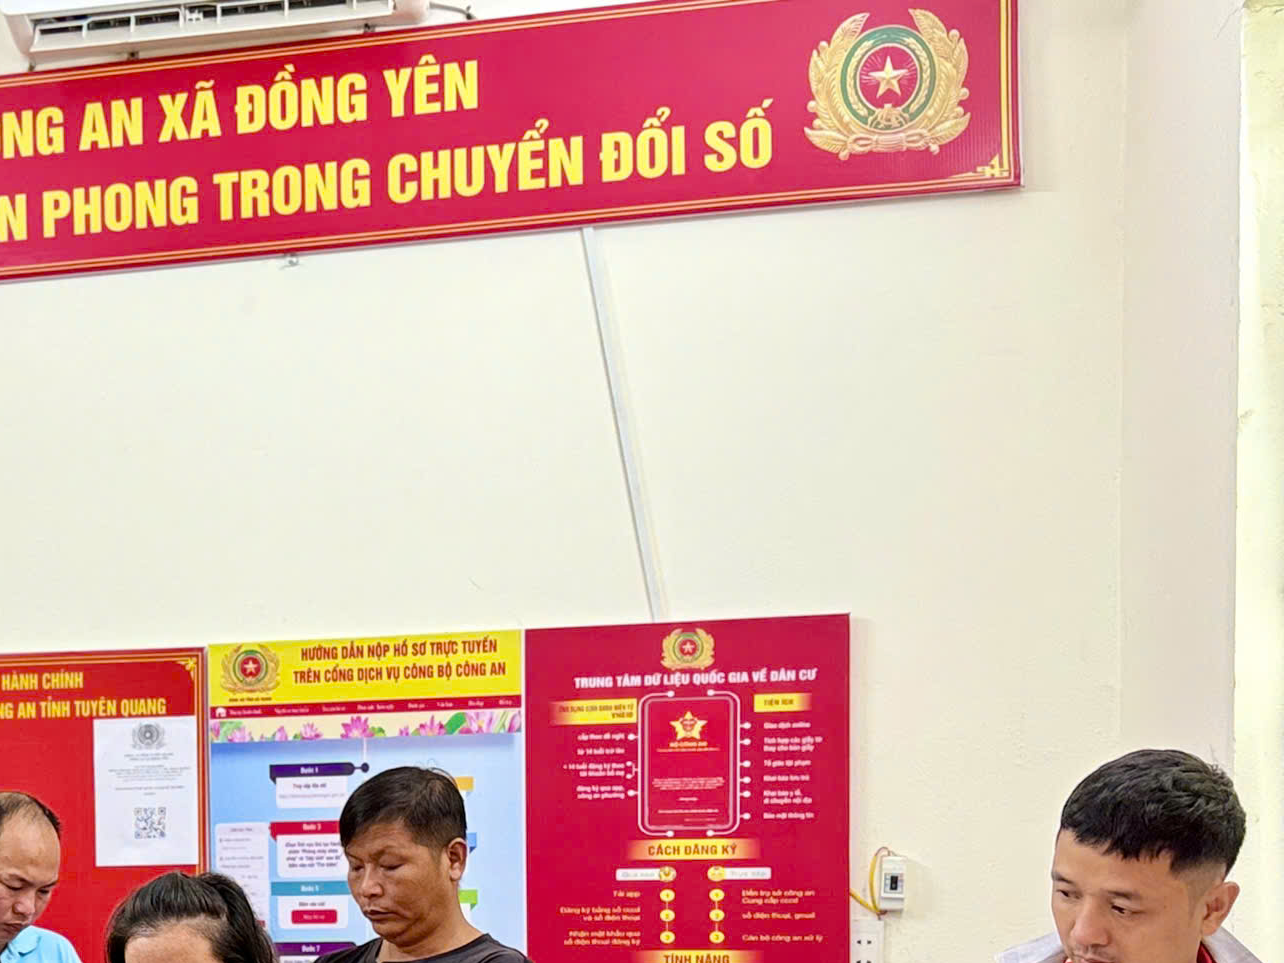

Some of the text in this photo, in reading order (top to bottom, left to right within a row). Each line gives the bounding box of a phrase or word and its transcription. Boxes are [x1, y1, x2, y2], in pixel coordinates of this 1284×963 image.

[79, 98, 143, 151] AN
[159, 80, 221, 142] XÃ
[235, 64, 367, 134] ĐỒNG
[383, 55, 478, 117] YÊN
[43, 176, 198, 238] PHONG
[213, 158, 370, 220] TRONG
[388, 119, 583, 203] CHUYỂN
[599, 107, 685, 182] ĐỔI
[704, 98, 773, 172] SỐ
[302, 638, 496, 660] HƯỚNG DẪN NỘP HỒ SƠ TRỰC TUYẾN
[2, 674, 38, 690] HÀNH
[42, 672, 83, 689] CHÍNH
[294, 661, 505, 683] TRÊN CỔNG DỊCH VỤ CÔNG BỘ CÔNG AN
[574, 668, 817, 688] TRUNG TÂM DỮ LIỆU QUỐC GIA VỀ DÂN CƯ
[18, 702, 36, 718] AN
[40, 697, 70, 717] TỈNH
[74, 697, 116, 716] TUYÊN
[120, 698, 167, 718] QUANG
[647, 842, 739, 857] CÁCH ĐĂNG KÝ
